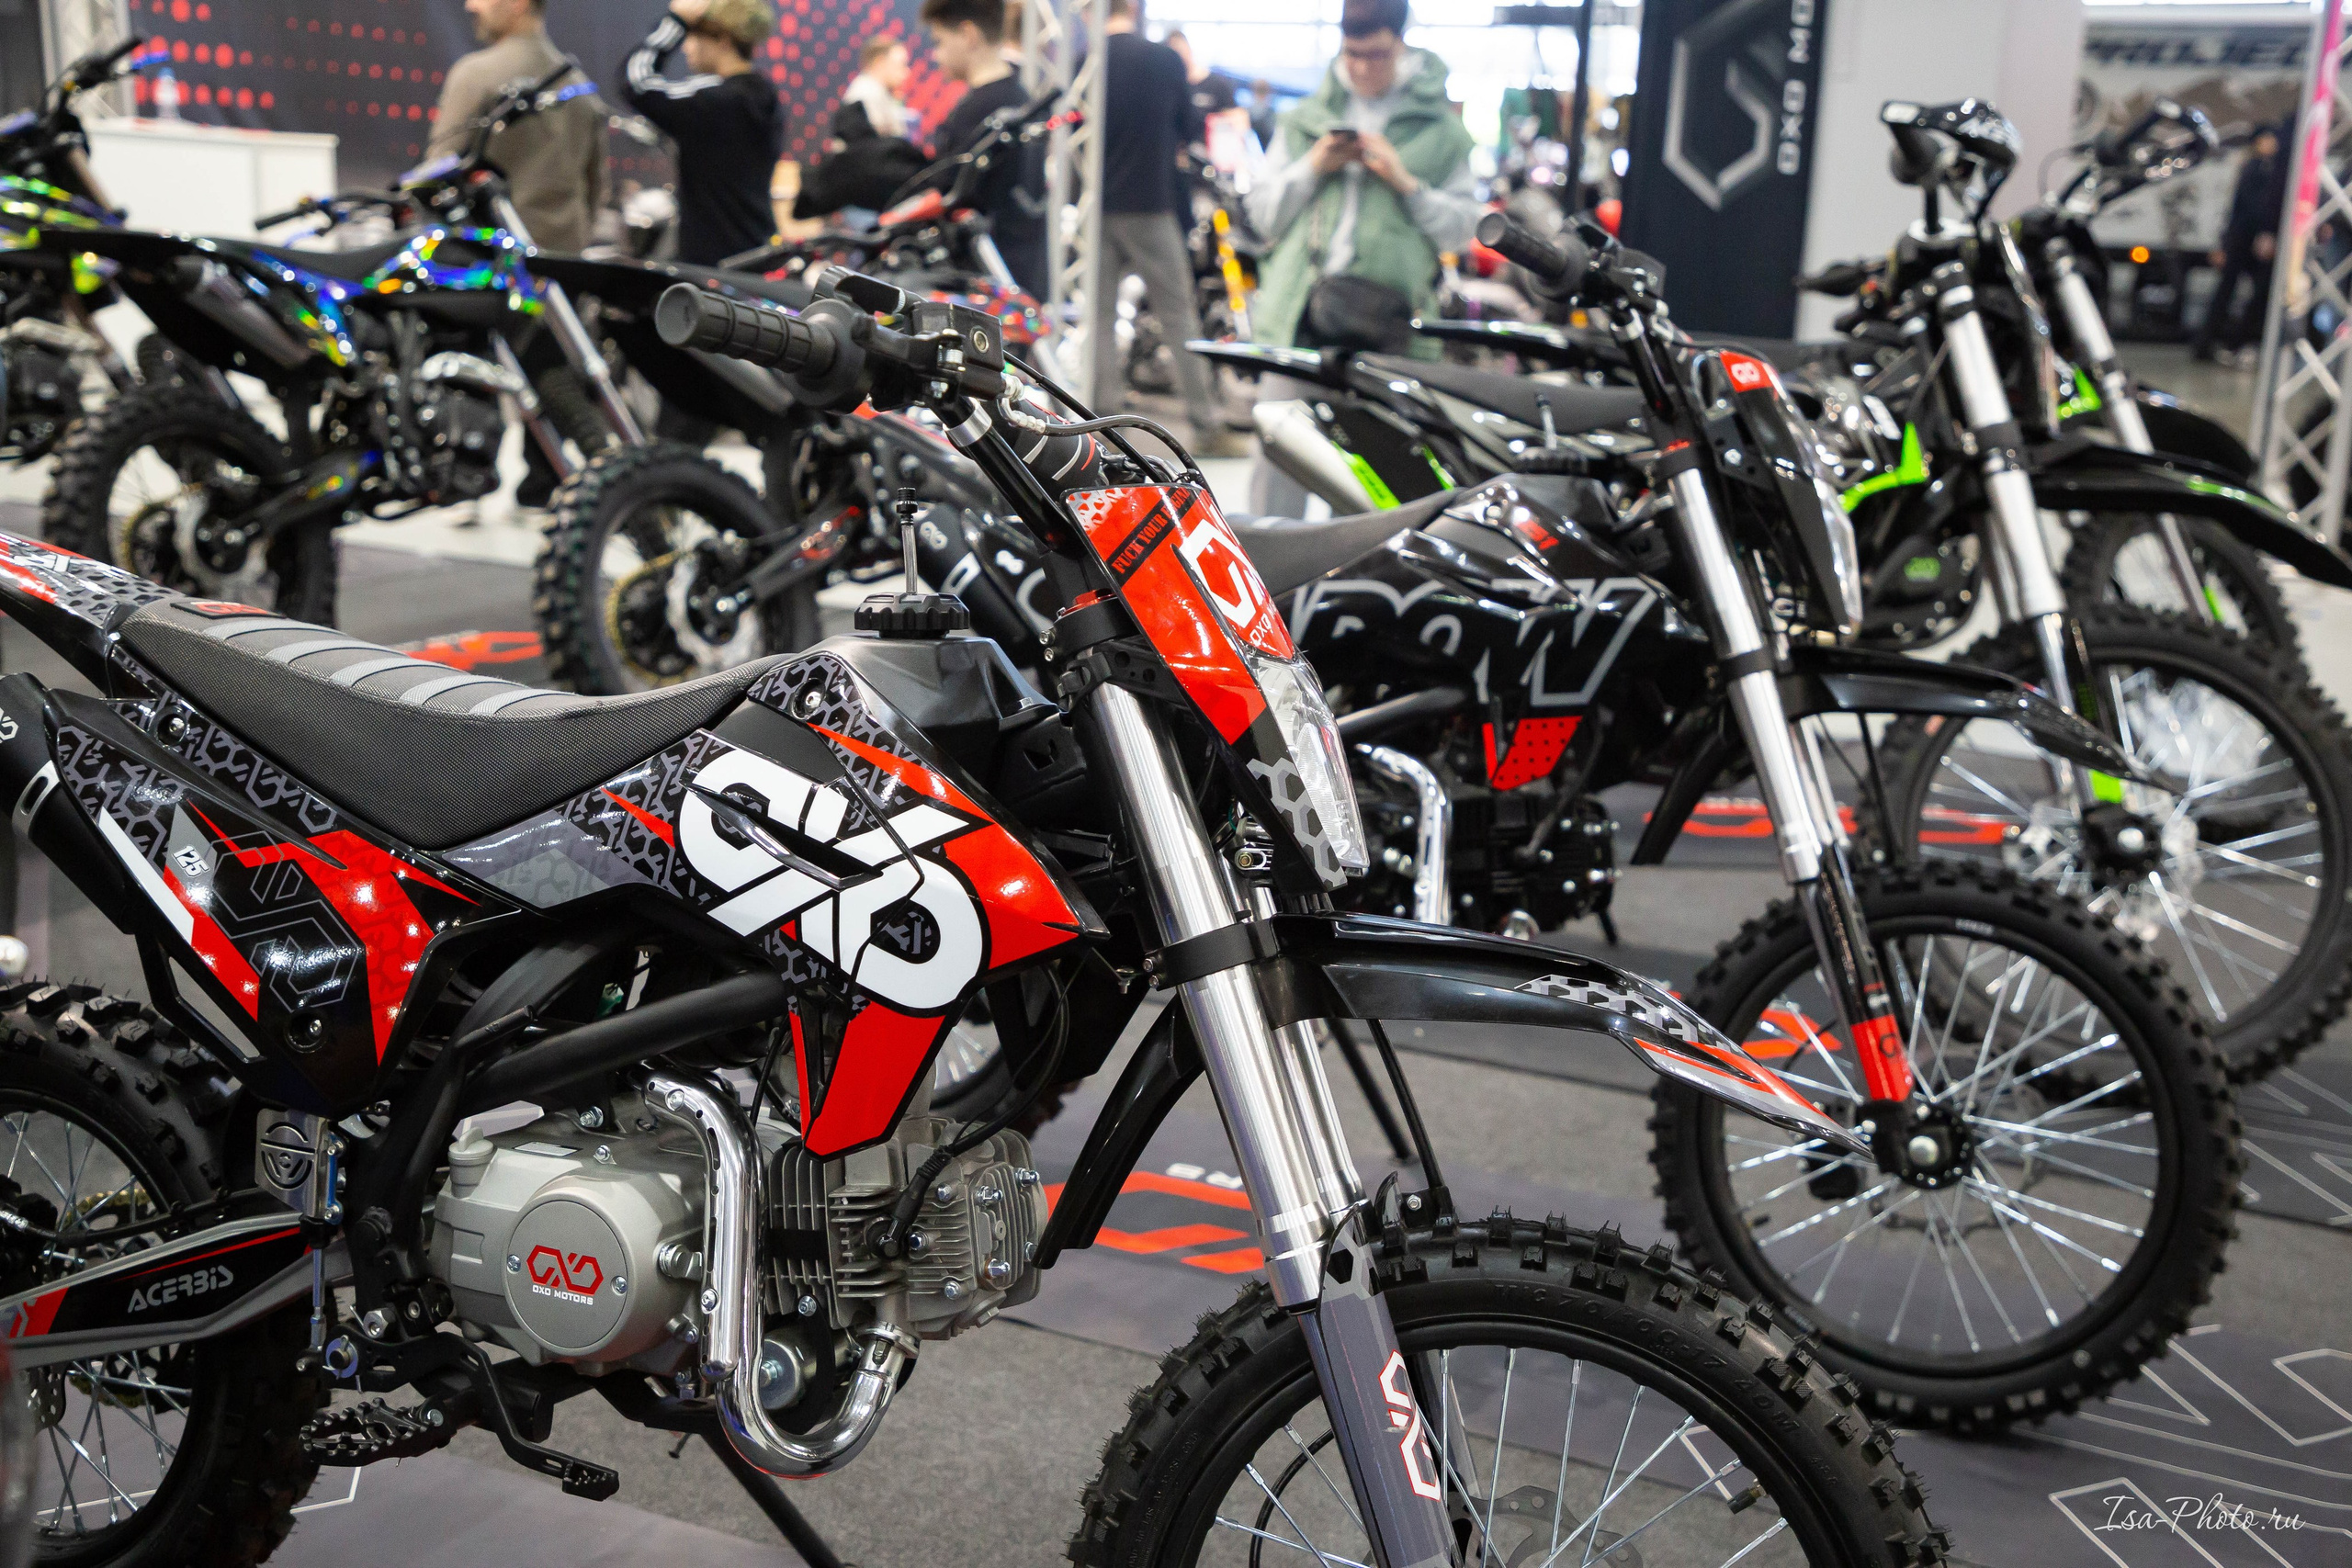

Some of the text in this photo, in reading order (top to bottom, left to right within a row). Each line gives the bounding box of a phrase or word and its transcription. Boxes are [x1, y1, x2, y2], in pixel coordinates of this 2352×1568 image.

[1777, 78, 1807, 175] OXO
[1111, 540, 1145, 574] FUCK
[1137, 513, 1169, 545] YOUR
[172, 845, 210, 877] 125
[532, 1284, 594, 1305] OXO MOTORS
